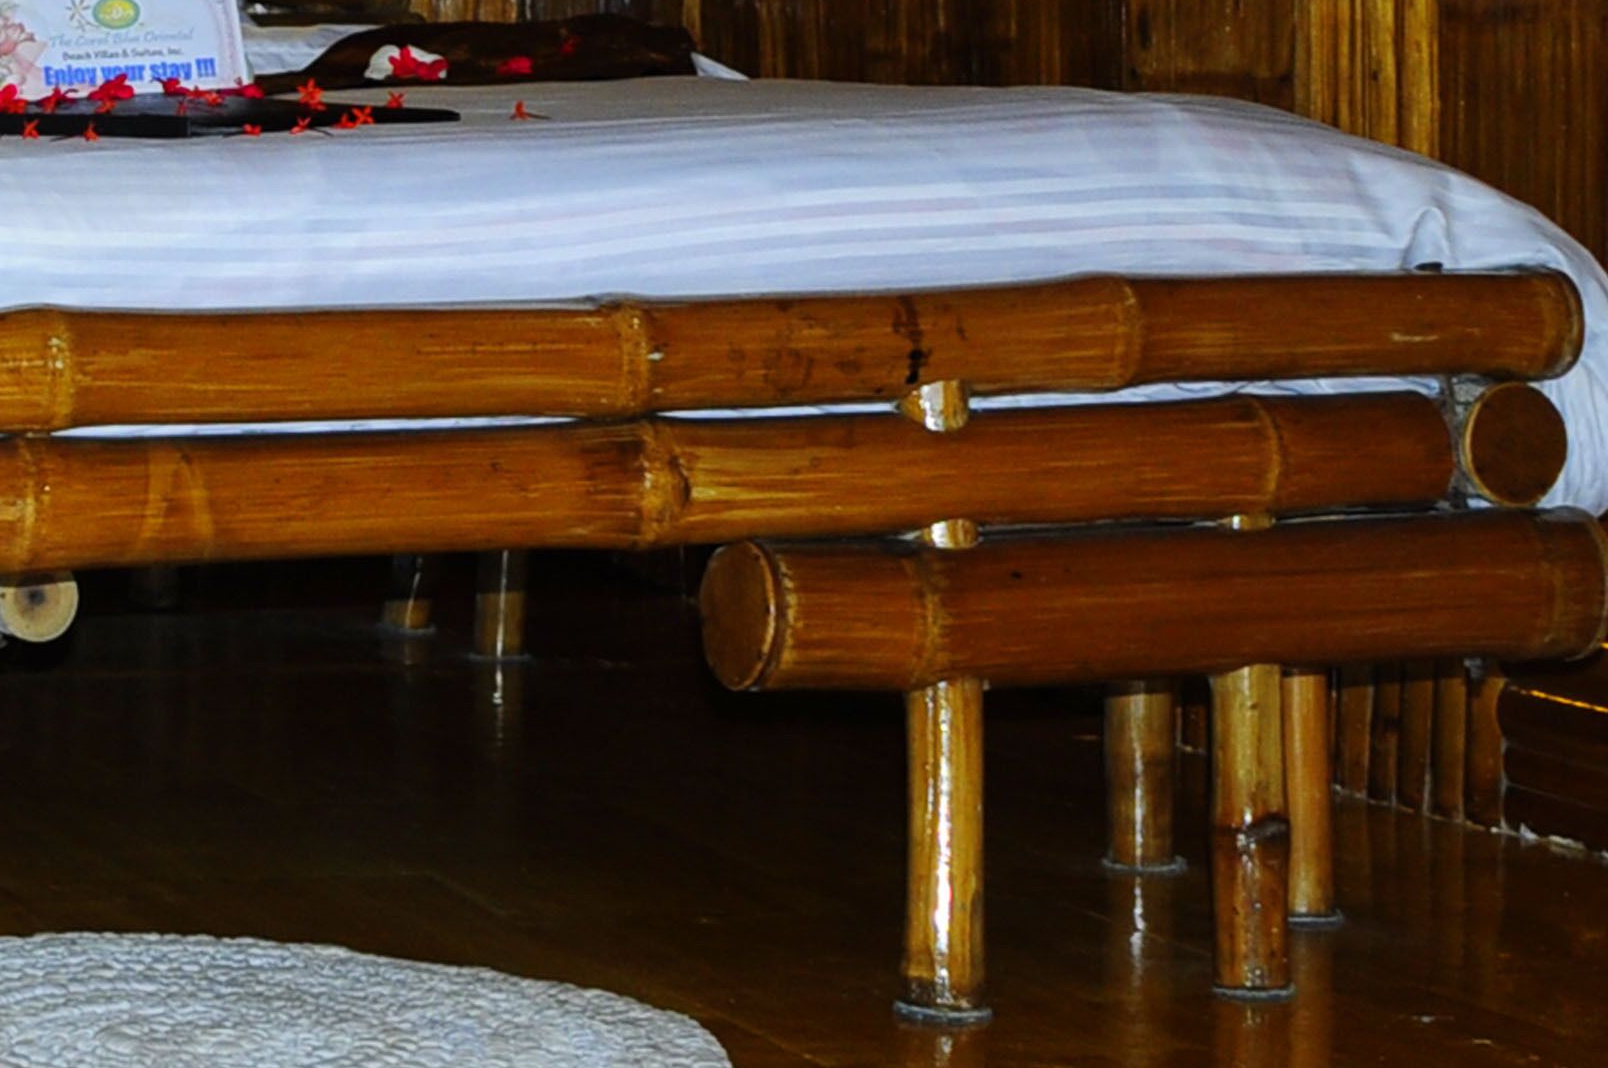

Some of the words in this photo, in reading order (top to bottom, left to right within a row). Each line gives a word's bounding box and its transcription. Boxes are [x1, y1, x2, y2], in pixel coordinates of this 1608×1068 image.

[50, 33, 74, 47] The
[43, 64, 97, 86] Enjoy
[100, 63, 146, 83] your
[149, 60, 192, 81] stay
